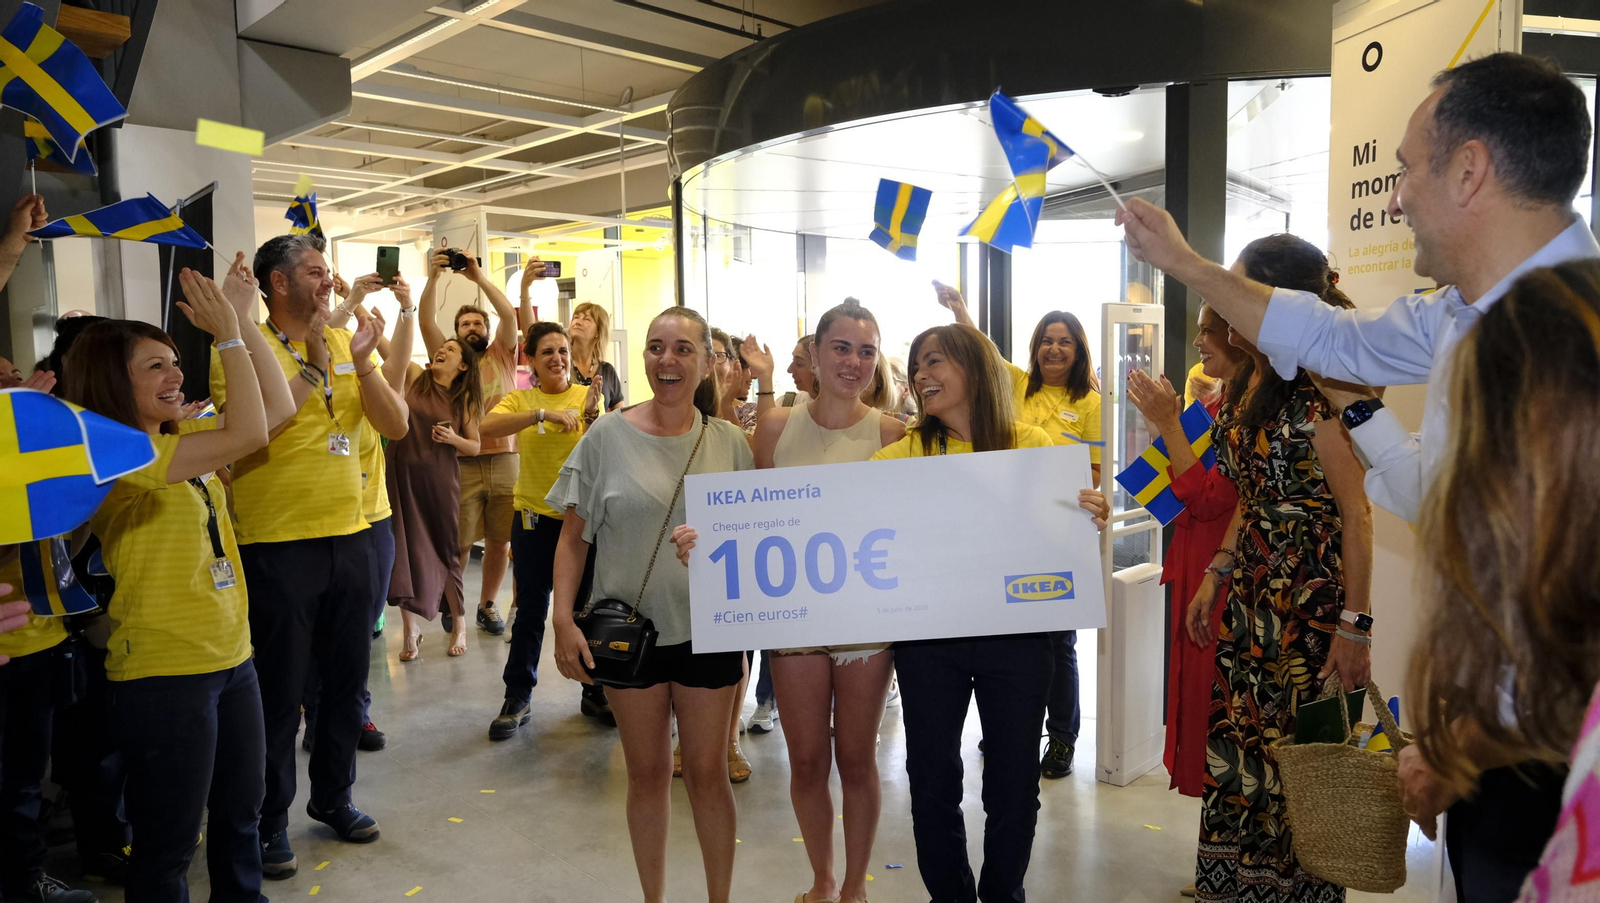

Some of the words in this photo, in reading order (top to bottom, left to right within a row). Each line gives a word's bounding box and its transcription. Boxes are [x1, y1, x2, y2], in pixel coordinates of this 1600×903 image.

[1353, 139, 1377, 167] Mi
[1350, 207, 1374, 231] de
[1348, 247, 1360, 258] La
[1362, 240, 1399, 257] alegría
[1401, 238, 1415, 250] de
[1348, 260, 1399, 275] encontrar
[1402, 257, 1412, 269] la
[707, 489, 747, 506] IKEA
[750, 483, 821, 503] Almería
[712, 520, 751, 533] Cheque
[753, 518, 785, 531] regalo
[787, 517, 801, 528] de
[708, 528, 899, 600] 100€
[1012, 580, 1068, 594] IKEA
[713, 611, 754, 624] #Cien
[758, 606, 808, 622] euros#
